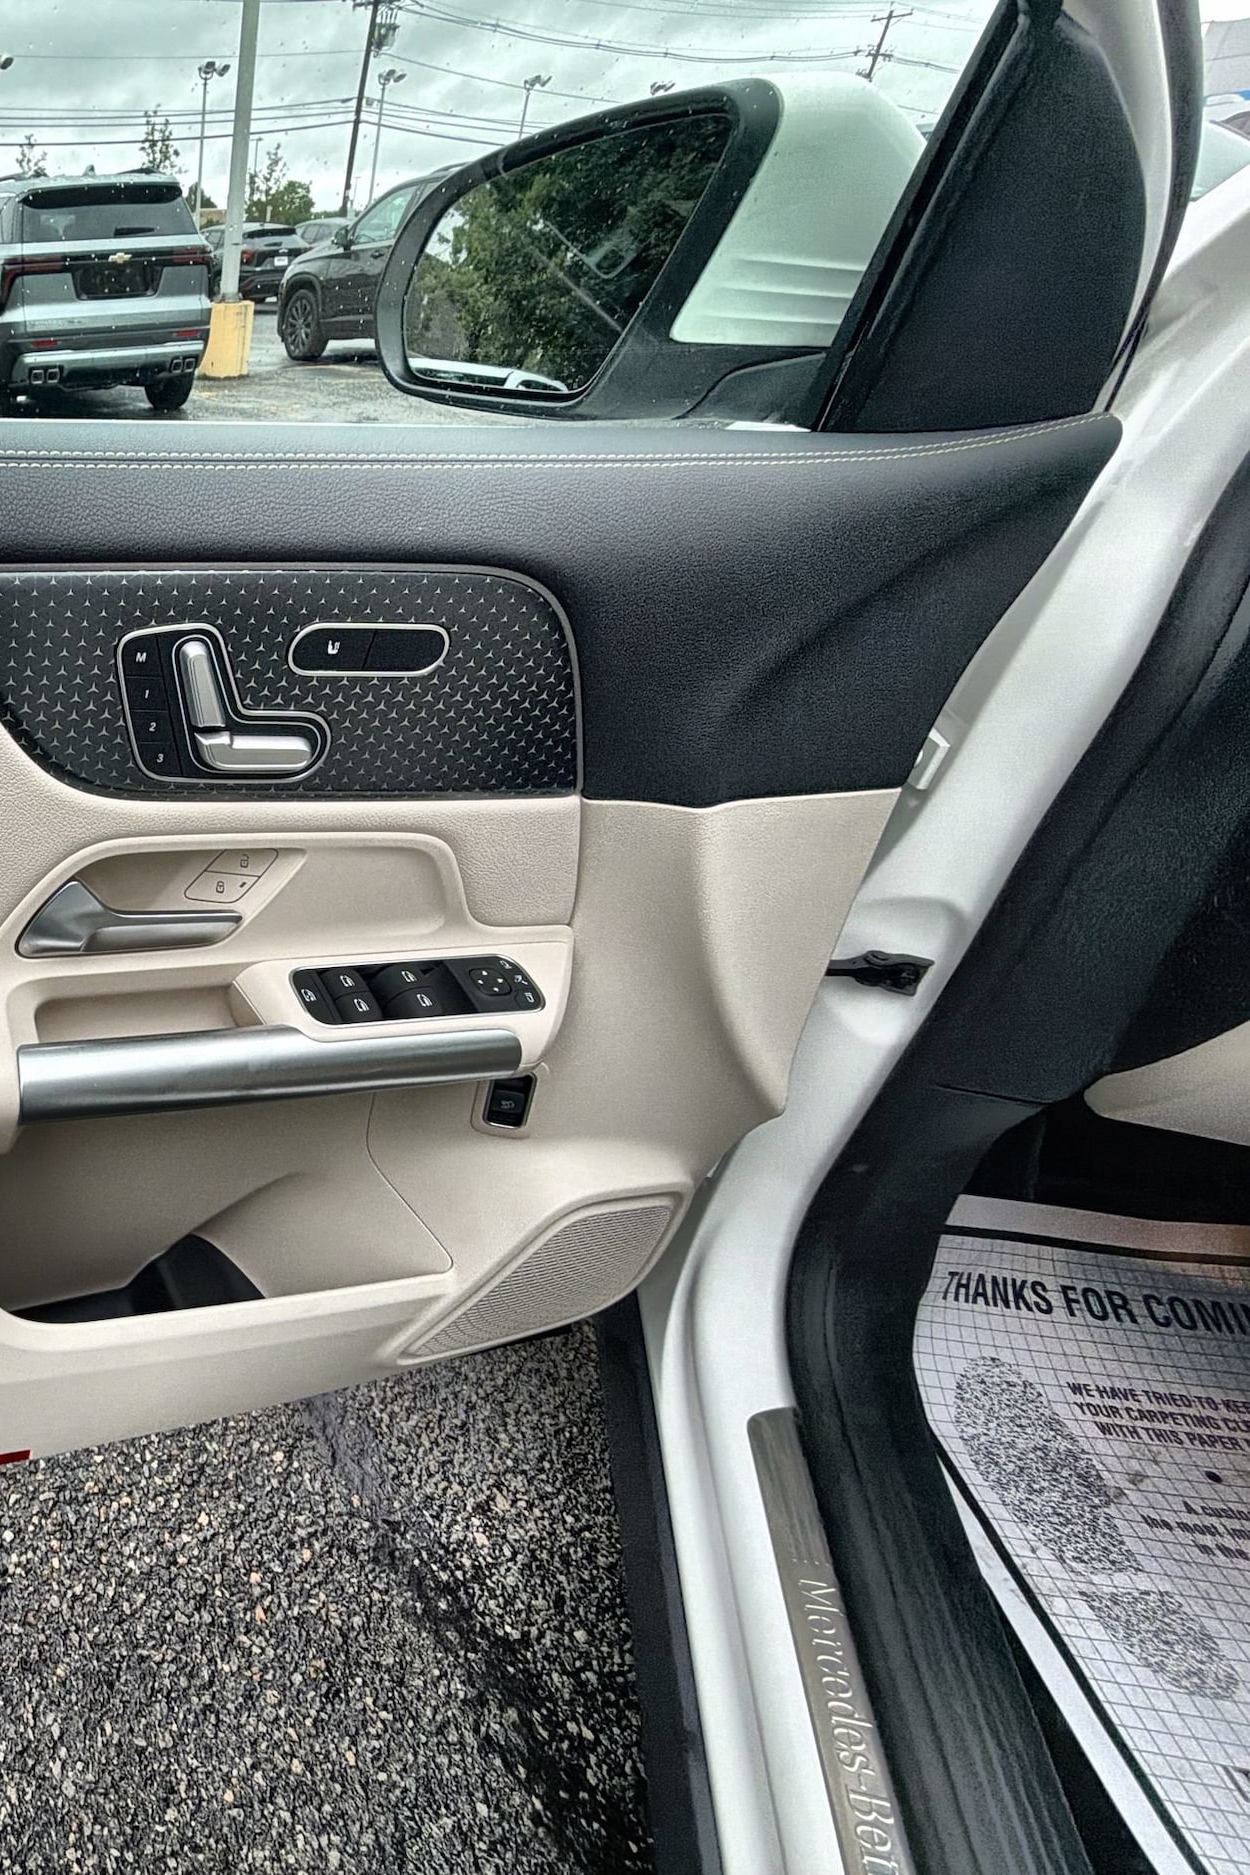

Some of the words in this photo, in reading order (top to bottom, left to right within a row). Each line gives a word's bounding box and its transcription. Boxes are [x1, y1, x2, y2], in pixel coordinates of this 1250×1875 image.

[136, 652, 147, 663] M
[145, 689, 149, 699] 1
[149, 722, 156, 732] 2
[156, 753, 164, 763] 3
[942, 1271, 1053, 1315] THANKS
[1060, 1284, 1138, 1324] FOR
[1066, 1381, 1095, 1398] WE
[1099, 1385, 1140, 1403] HAVE
[1141, 1389, 1192, 1409] TRIED
[1193, 1396, 1219, 1411] TO
[1073, 1402, 1123, 1419] YOUR
[1126, 1407, 1221, 1430] CARPETING
[1094, 1421, 1142, 1440] WITH
[1141, 1427, 1184, 1446] THIS
[1184, 1431, 1245, 1451] PAPER
[1182, 1500, 1202, 1515] A
[1200, 1504, 1250, 1521] custo
[1140, 1514, 1173, 1531] the
[1175, 1521, 1224, 1538] most
[1215, 1542, 1250, 1561] the
